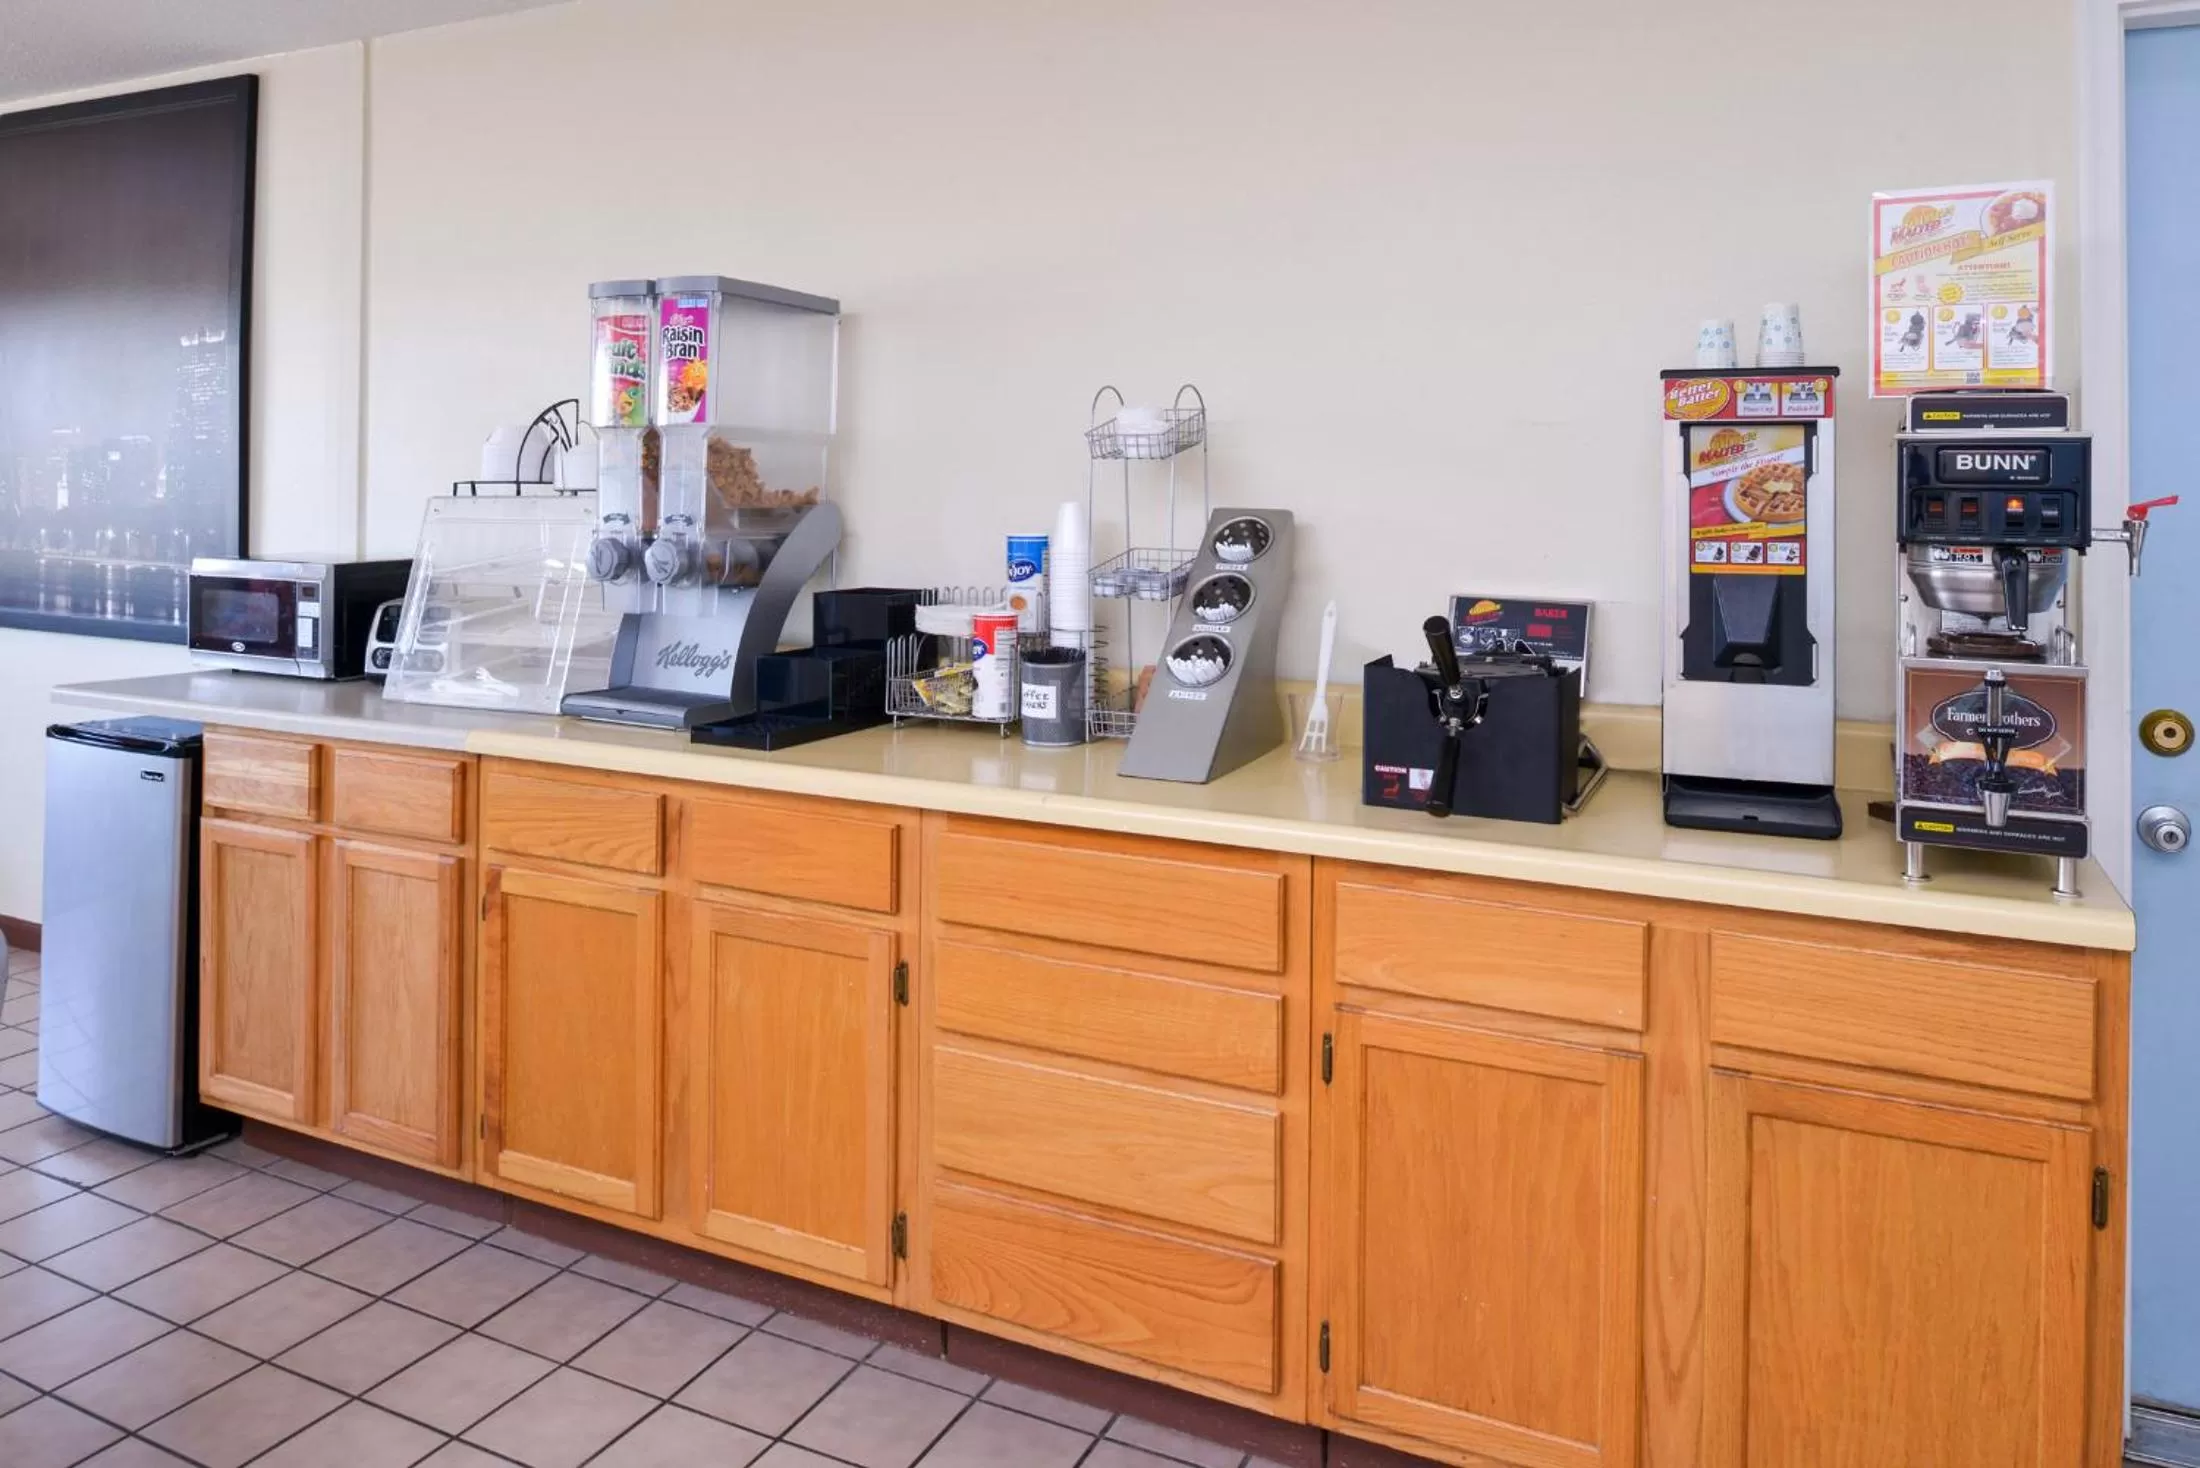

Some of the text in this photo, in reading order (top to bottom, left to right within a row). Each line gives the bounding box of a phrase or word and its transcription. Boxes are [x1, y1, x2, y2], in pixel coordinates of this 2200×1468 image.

[663, 326, 703, 344] Raisin
[666, 343, 698, 359] Bran
[1678, 389, 1720, 407] Batter
[1956, 453, 2030, 471] BUNN
[656, 640, 732, 678] Kellogg's
[1947, 706, 1987, 724] Farmer
